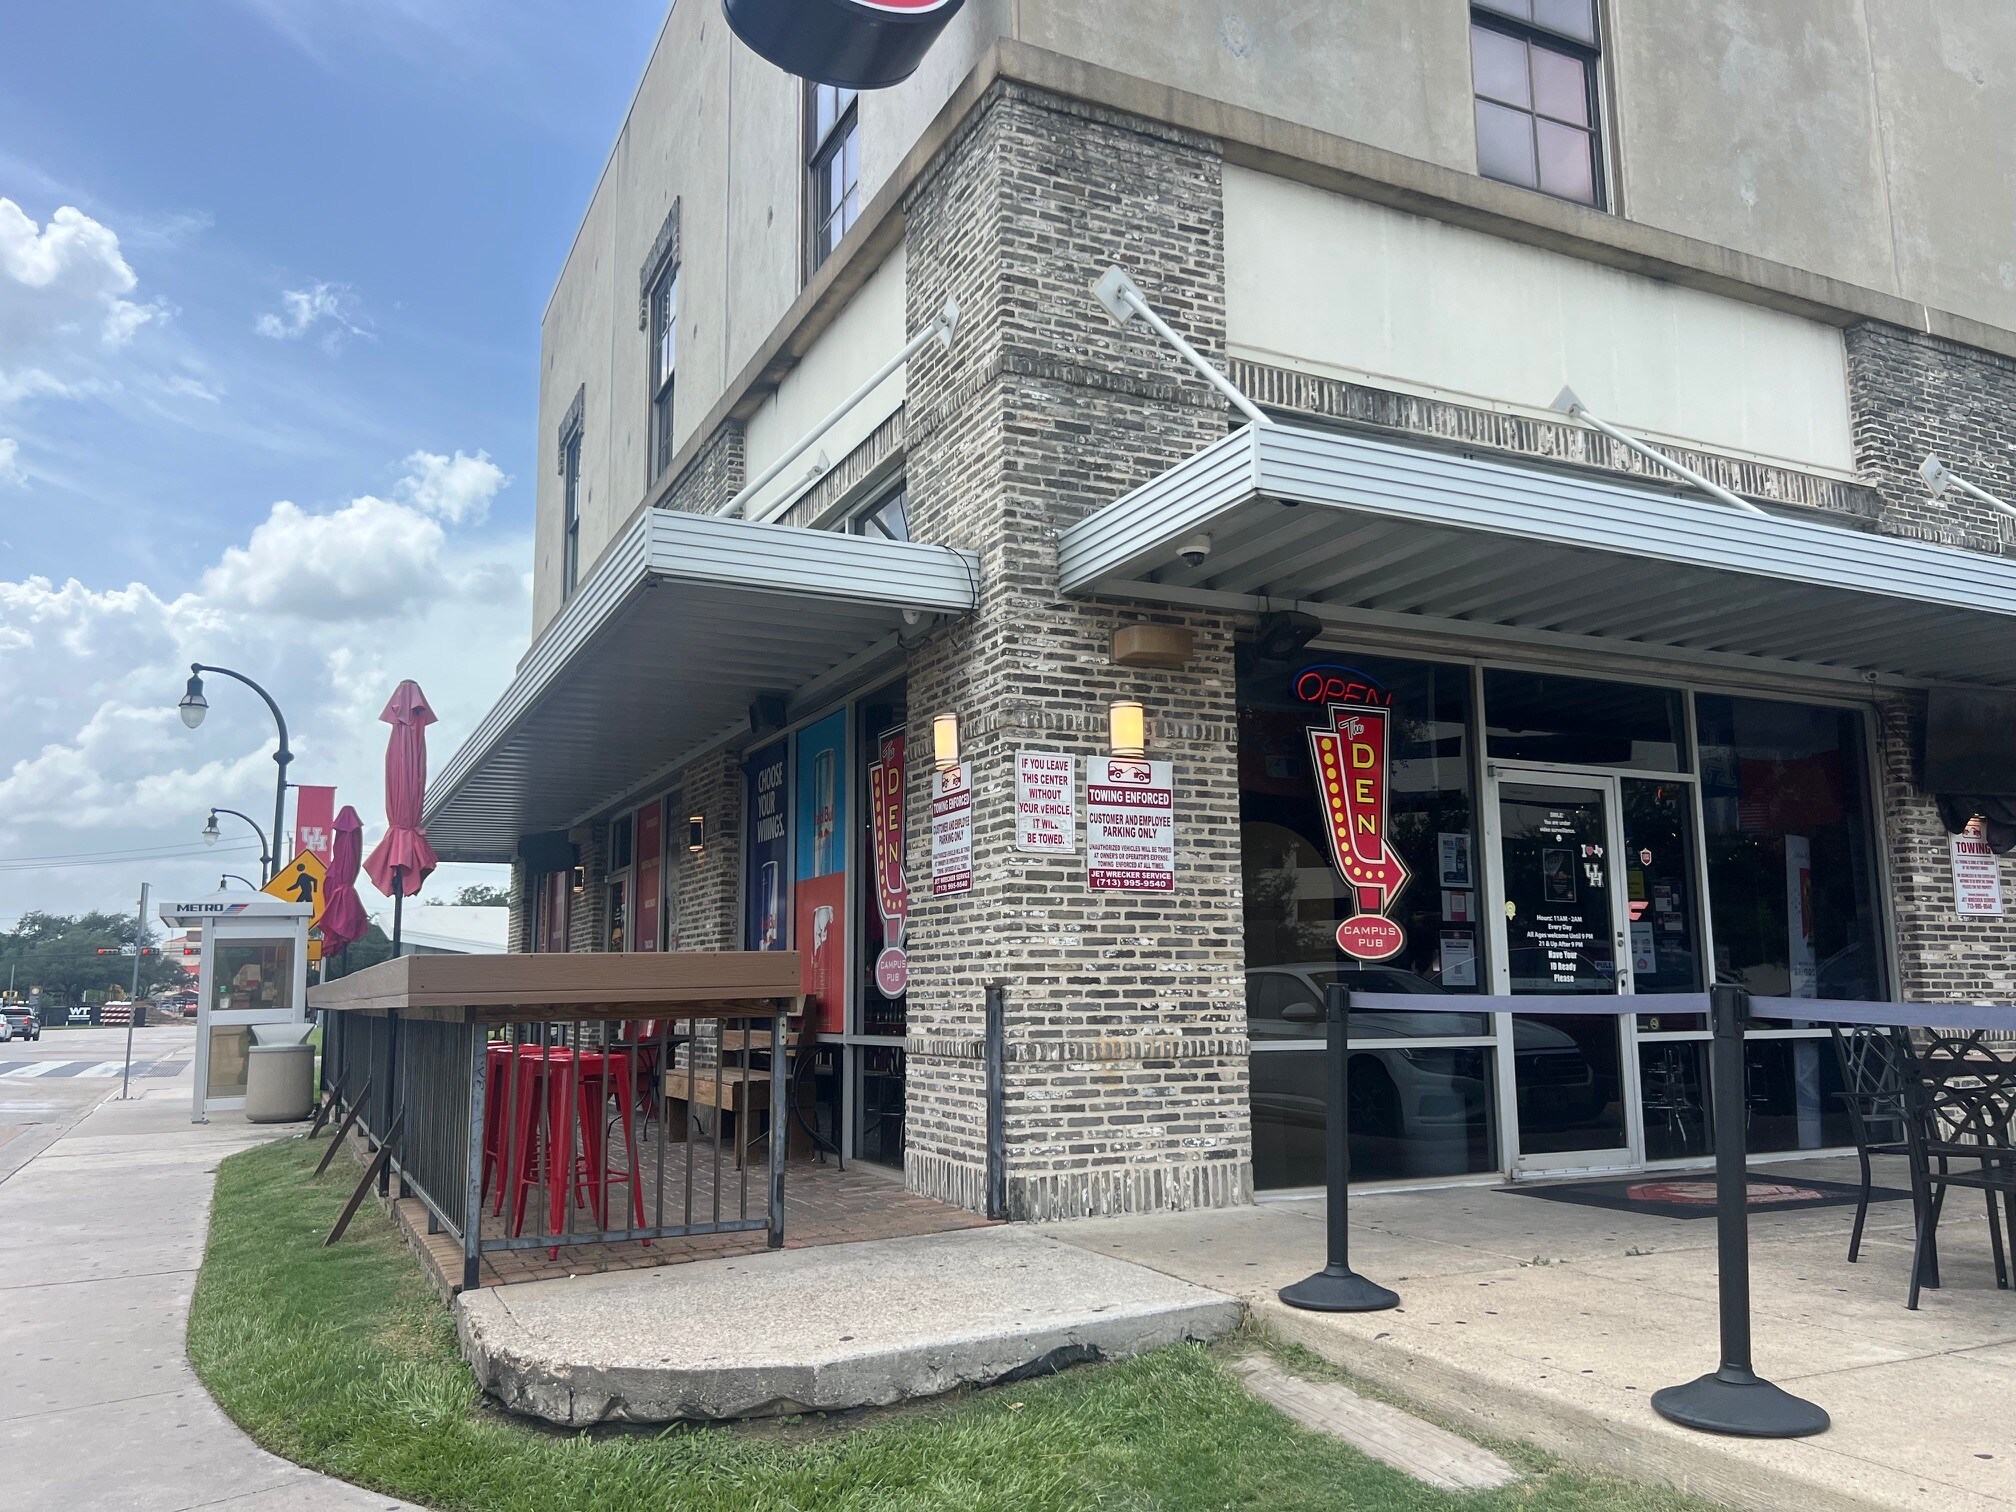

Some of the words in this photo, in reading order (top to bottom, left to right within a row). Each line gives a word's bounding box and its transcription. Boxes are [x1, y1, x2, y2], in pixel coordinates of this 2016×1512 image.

[1297, 672, 1392, 705] OPEN
[1337, 715, 1365, 740] The
[1021, 758, 1028, 768] IF
[1030, 759, 1045, 770] YOU
[1046, 760, 1069, 771] LEAVE
[758, 762, 783, 793] CHOOSE
[1022, 773, 1039, 784] THIS
[1040, 774, 1068, 786] CENTER
[1029, 788, 1062, 800] WITHOUT
[1351, 742, 1377, 836] DEN
[933, 800, 949, 815] TOWING
[949, 792, 970, 810] ENFORCED
[1089, 789, 1123, 803] TOWING
[1125, 791, 1170, 806] ENFORCED
[757, 790, 776, 818] YOUR
[887, 766, 900, 864] DEN
[1089, 812, 1124, 825] CUSTOMER
[1125, 814, 1138, 826] AND
[1139, 815, 1171, 827] EMPLOYEE
[1033, 818, 1041, 828] IT
[1103, 825, 1136, 838] PARKING
[1138, 828, 1158, 839] ONLY
[301, 826, 328, 852] UH
[1027, 833, 1037, 844] BE
[1038, 834, 1065, 845] TOWED.
[1158, 846, 1172, 854] TOWED
[1955, 841, 1991, 855] TOWING
[1097, 860, 1114, 868] TOWING
[1115, 861, 1137, 869] ENFORCED
[1091, 870, 1105, 878] JET
[1106, 870, 1141, 879] WRECKER
[1142, 872, 1172, 880] SERVICE
[1096, 878, 1121, 887] (713)
[1123, 879, 1166, 888] 995-9540
[176, 903, 224, 912] METRO
[1343, 925, 1397, 937] CAMPUS
[1547, 923, 1562, 931] Every
[1562, 924, 1573, 932] Day
[1534, 931, 1547, 939] Ages
[1357, 936, 1384, 948] PUB
[1548, 950, 1564, 959] Have
[1563, 950, 1578, 960] Your
[880, 959, 907, 970] CAMPUS
[1550, 962, 1558, 971] ID
[1557, 962, 1577, 972] Ready
[886, 973, 900, 982] PUB
[1553, 974, 1575, 983] Please
[69, 1007, 92, 1015] WT
